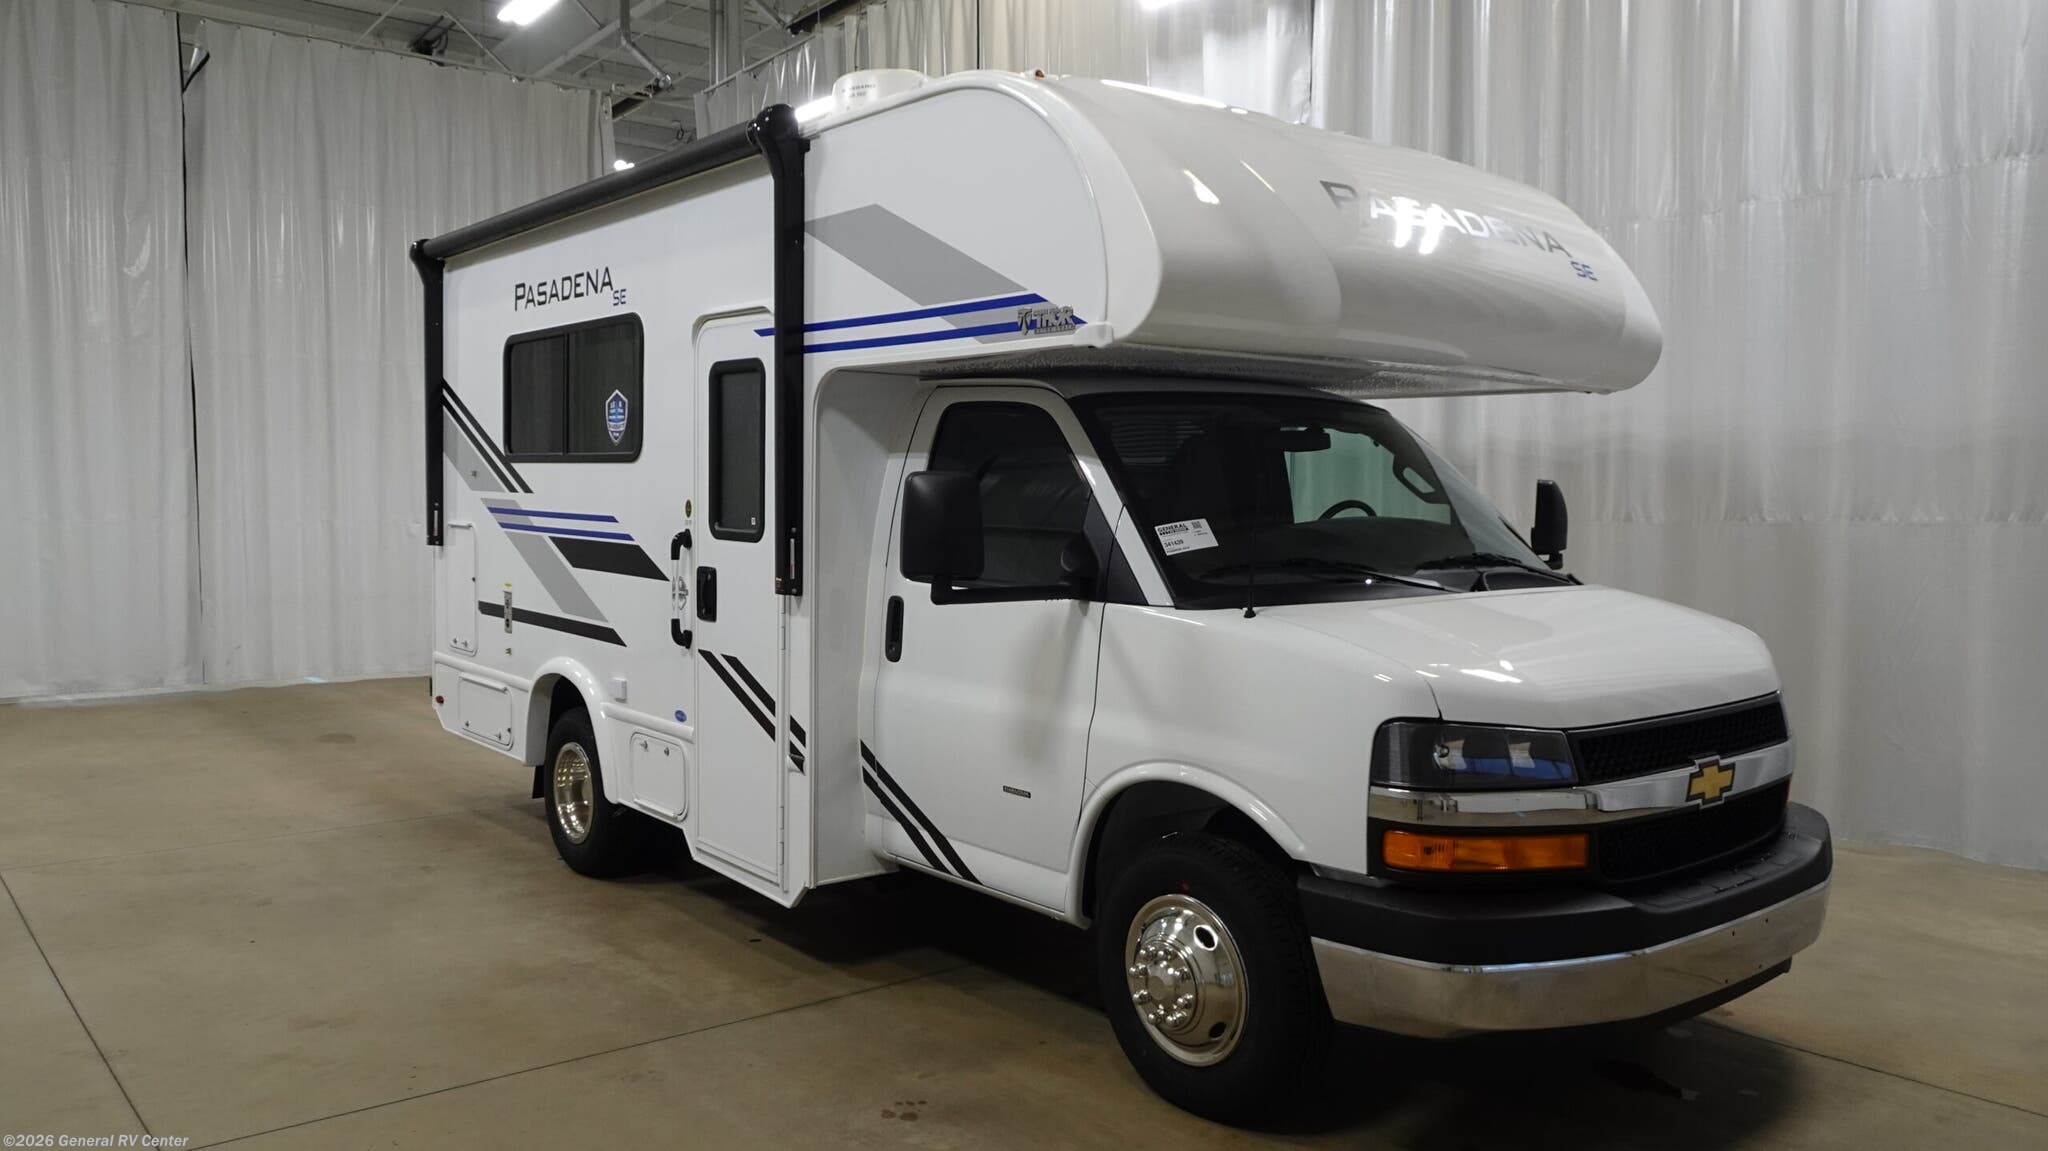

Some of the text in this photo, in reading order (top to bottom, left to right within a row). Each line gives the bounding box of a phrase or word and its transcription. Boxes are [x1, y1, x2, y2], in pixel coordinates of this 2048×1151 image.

[1570, 260, 1598, 281] SE
[514, 266, 627, 312] PASADENA SE
